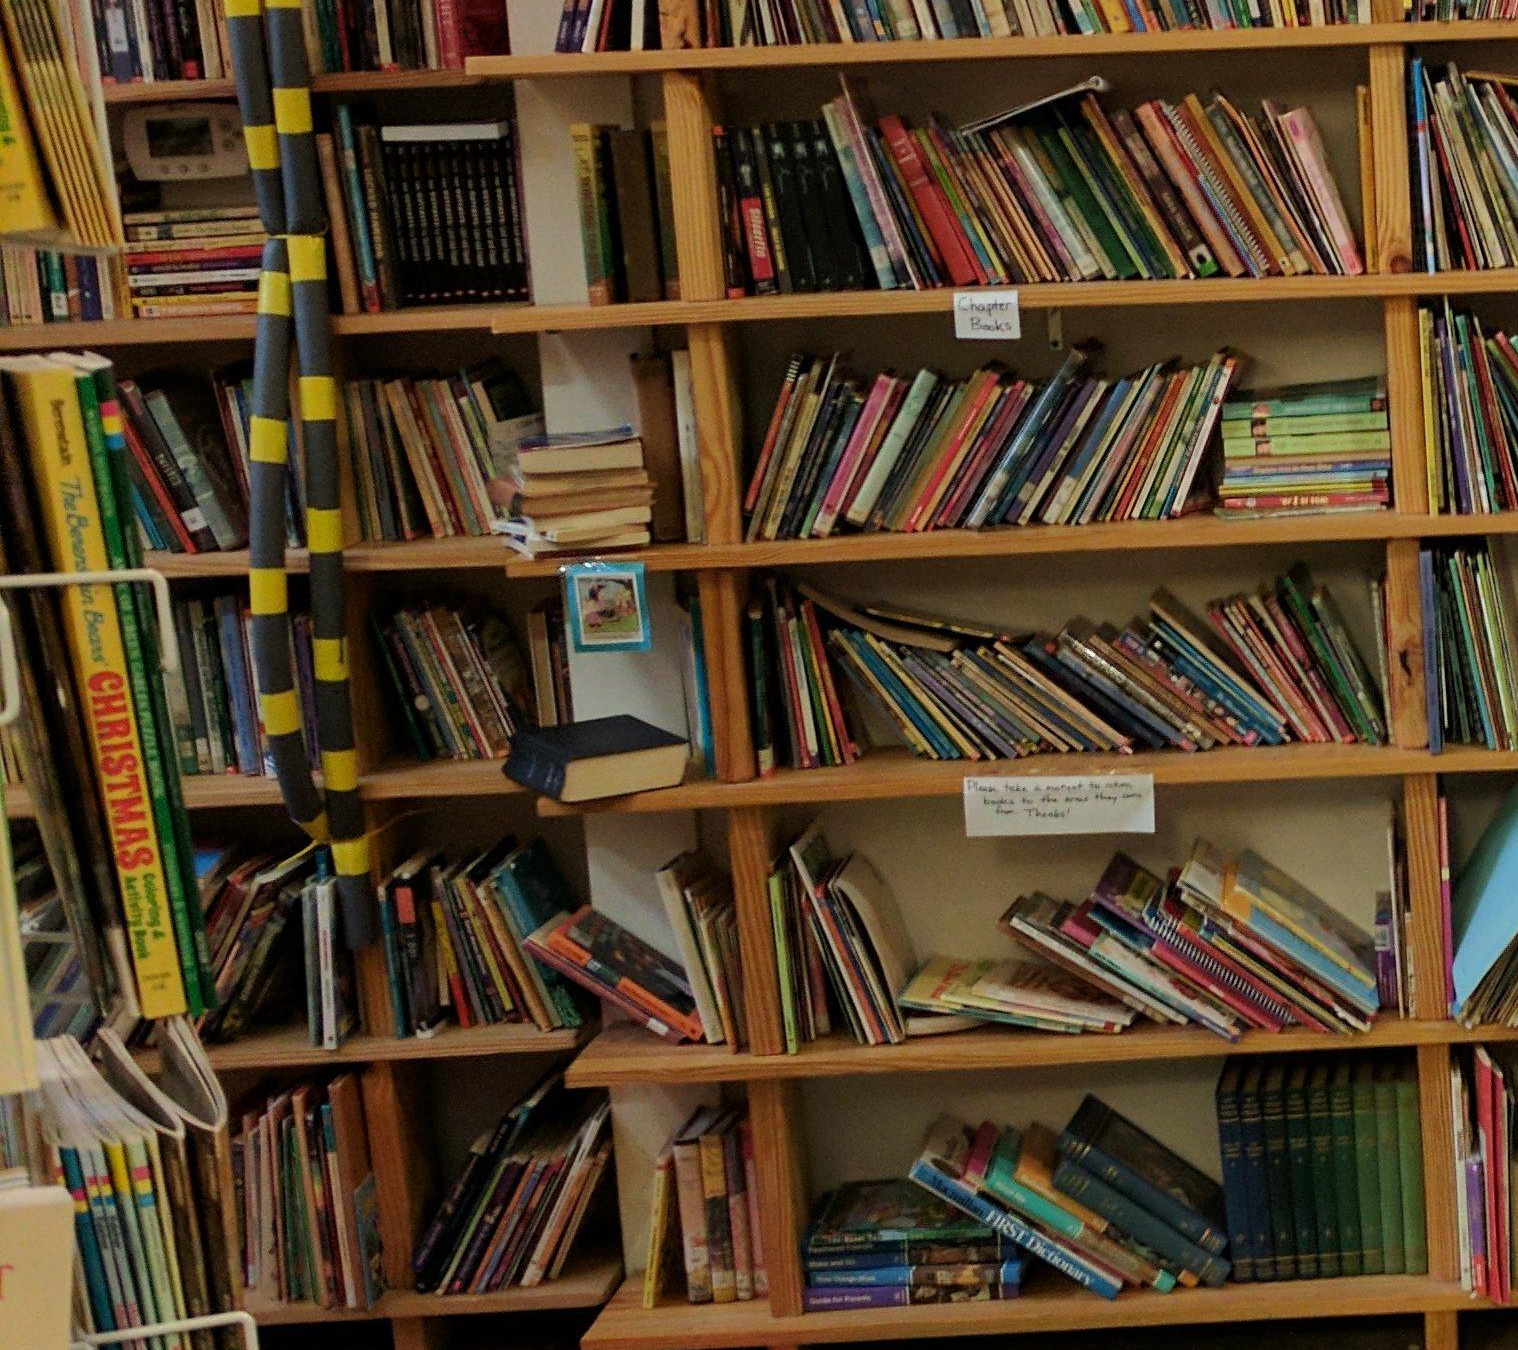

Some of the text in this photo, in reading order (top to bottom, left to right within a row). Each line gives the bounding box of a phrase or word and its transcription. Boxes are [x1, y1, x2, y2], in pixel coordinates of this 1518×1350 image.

[957, 295, 1014, 317] Chapter
[87, 670, 156, 871] CHRISTMAS
[966, 779, 998, 792] Please
[1094, 792, 1119, 805] they
[984, 1209, 1027, 1243] FIRST
[1024, 1236, 1096, 1289] Dictionary
